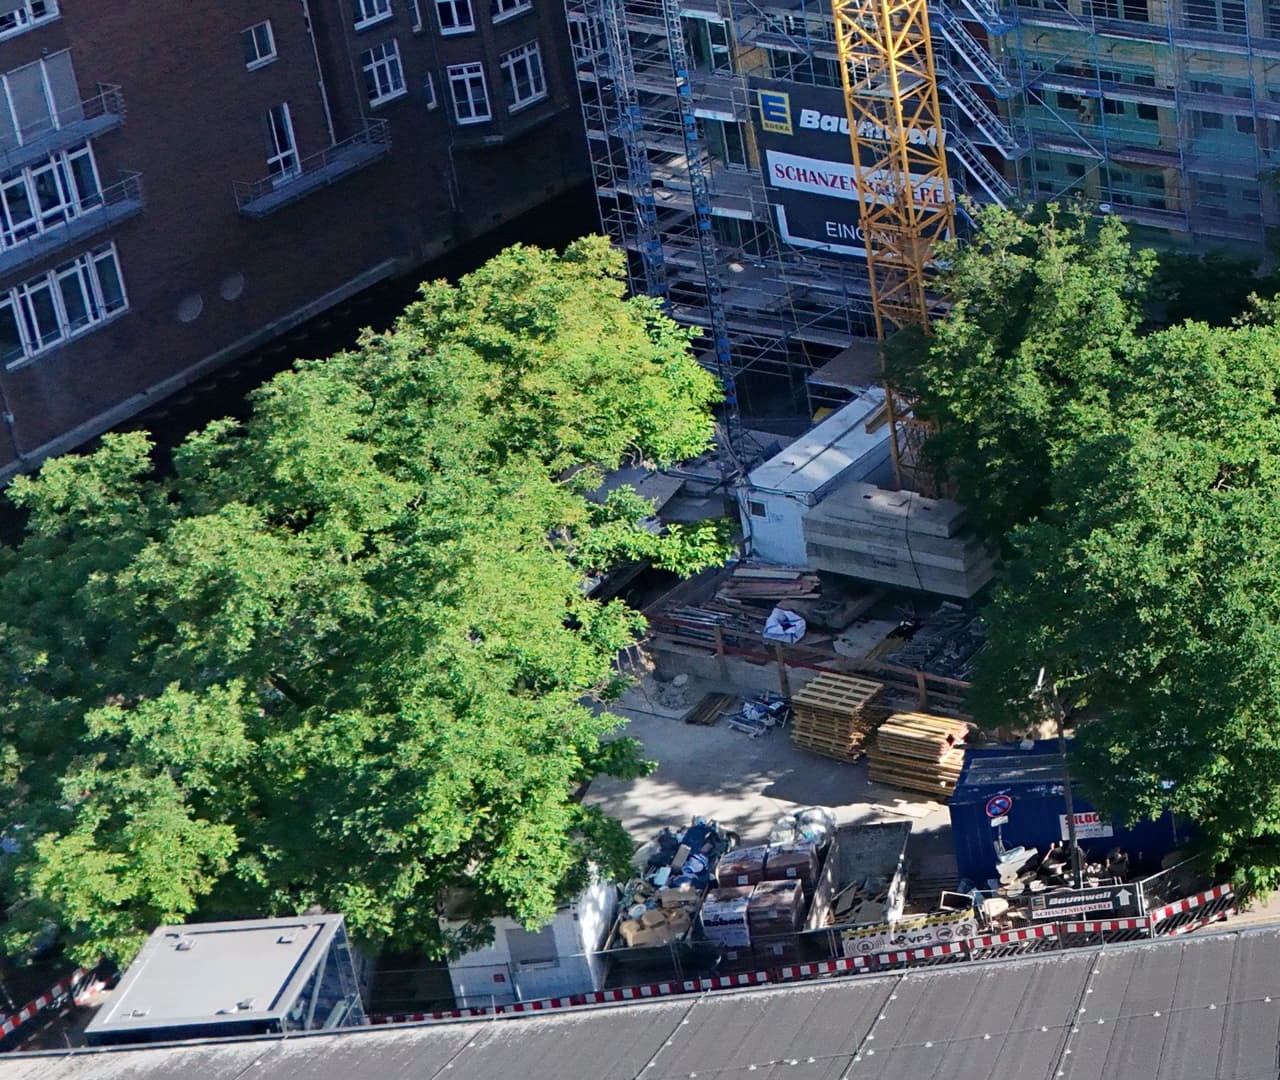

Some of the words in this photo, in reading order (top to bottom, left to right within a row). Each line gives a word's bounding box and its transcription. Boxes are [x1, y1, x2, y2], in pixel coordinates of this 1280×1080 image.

[774, 163, 953, 204] SCHANZENBÄERE
[825, 221, 906, 246] EINGAN
[1048, 891, 1112, 905] Baumwall
